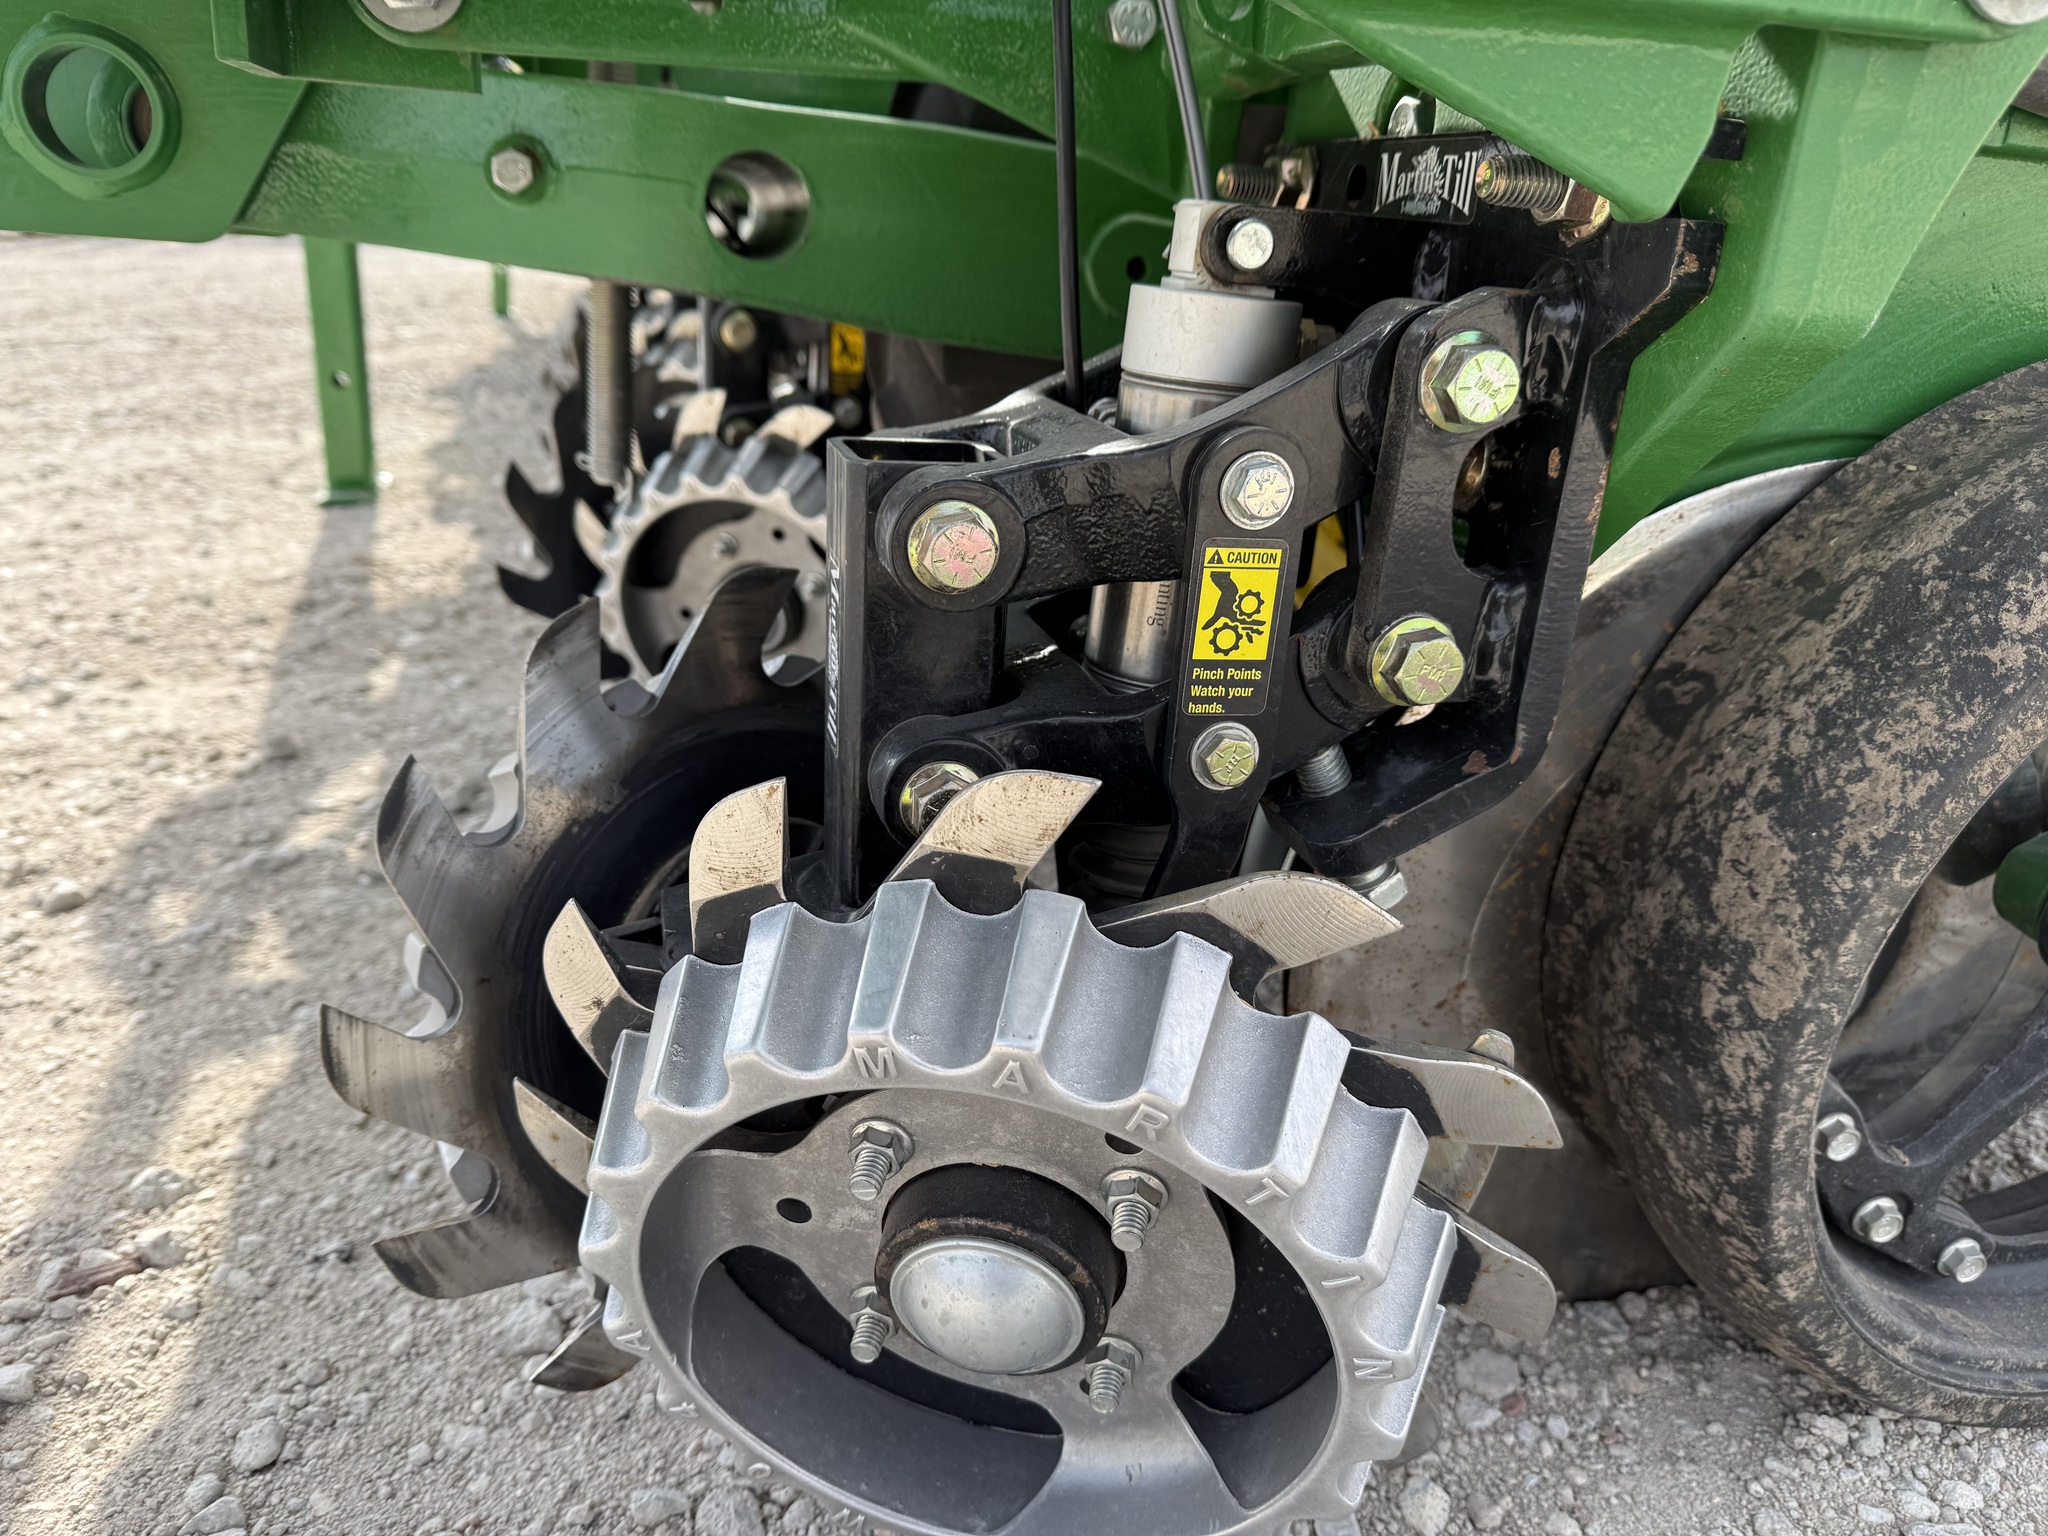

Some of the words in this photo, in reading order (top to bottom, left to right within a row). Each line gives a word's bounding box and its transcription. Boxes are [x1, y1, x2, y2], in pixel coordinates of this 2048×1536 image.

[1227, 552, 1277, 564] CAUTION
[1193, 668, 1223, 680] Pinch
[1227, 668, 1261, 680] Points
[1191, 685, 1225, 696] Watch
[1228, 687, 1253, 699] your
[1188, 702, 1225, 713] hands.
[853, 1045, 1394, 1381] MARTIN
